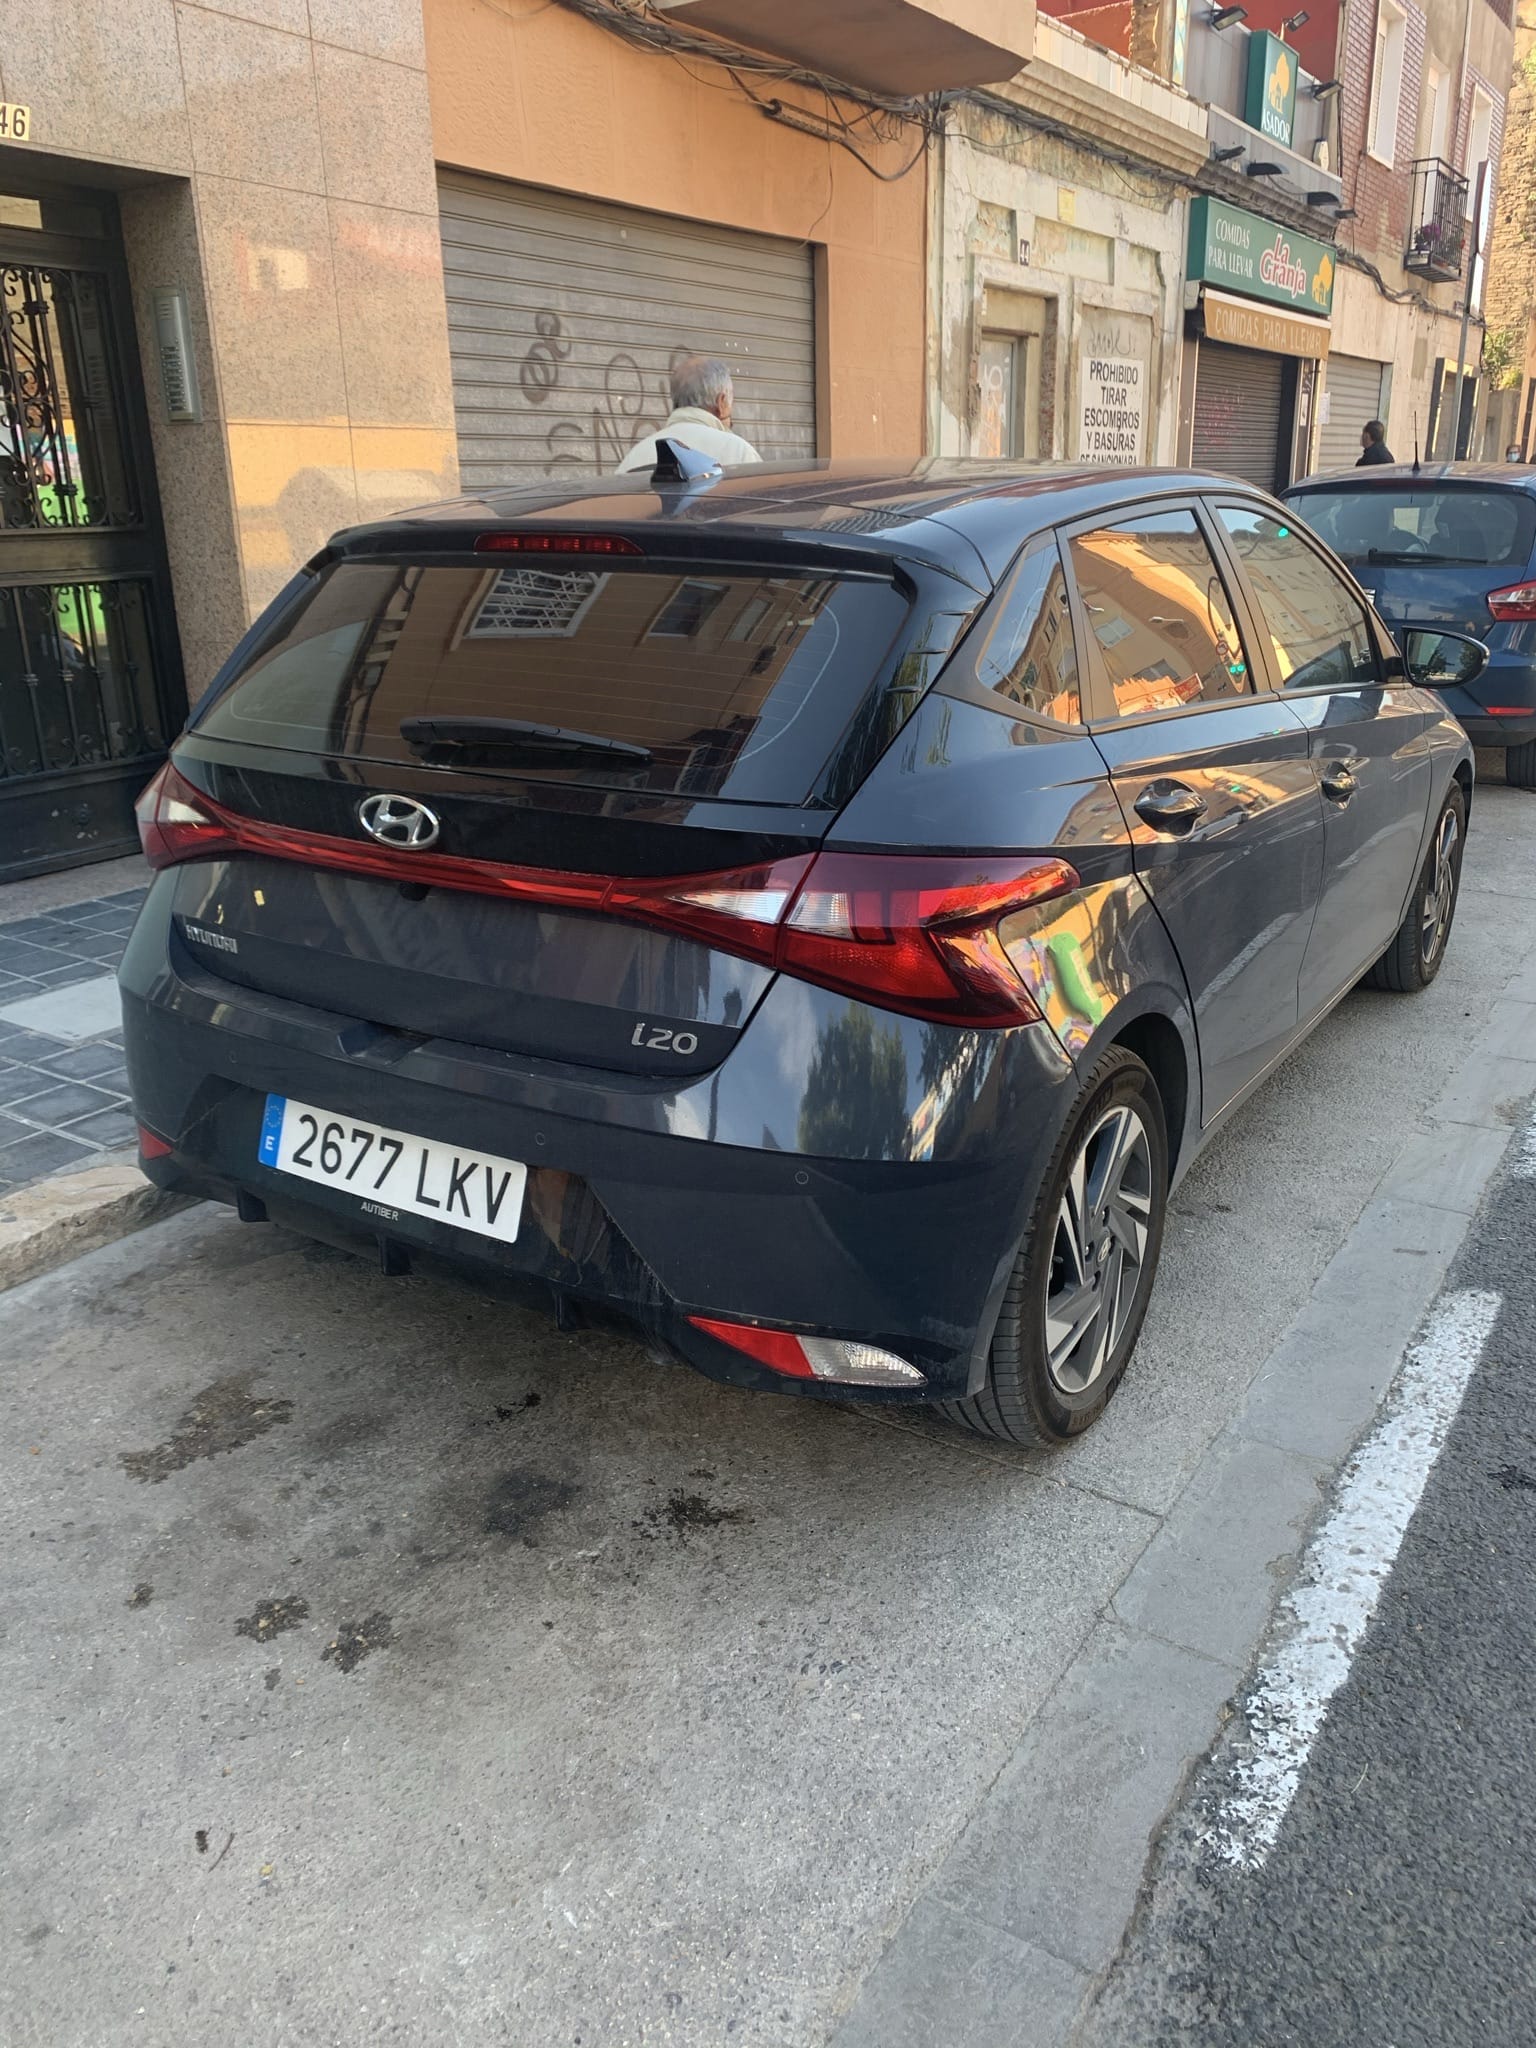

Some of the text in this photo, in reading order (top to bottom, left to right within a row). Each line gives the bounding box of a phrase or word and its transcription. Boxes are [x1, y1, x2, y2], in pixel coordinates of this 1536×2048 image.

[1261, 107, 1290, 144] ASADOR
[1215, 218, 1250, 249] COMIDAS
[1208, 245, 1253, 279] PARA LLEVAR
[1274, 234, 1290, 264] La
[1260, 250, 1306, 298] Granja
[1215, 308, 1321, 353] COMIDAS PARA LLEVAR
[1089, 360, 1139, 385] PROHIBIDO
[1101, 386, 1127, 406] TIRAR
[1084, 408, 1140, 429] ESCOMBROS
[1087, 432, 1136, 451] Y BASURAS
[185, 924, 238, 954] HYUNDAI
[631, 1022, 698, 1055] i20
[264, 1136, 274, 1150] E
[292, 1114, 512, 1225] 2677 LKV
[360, 1201, 399, 1221] AUTIBER
